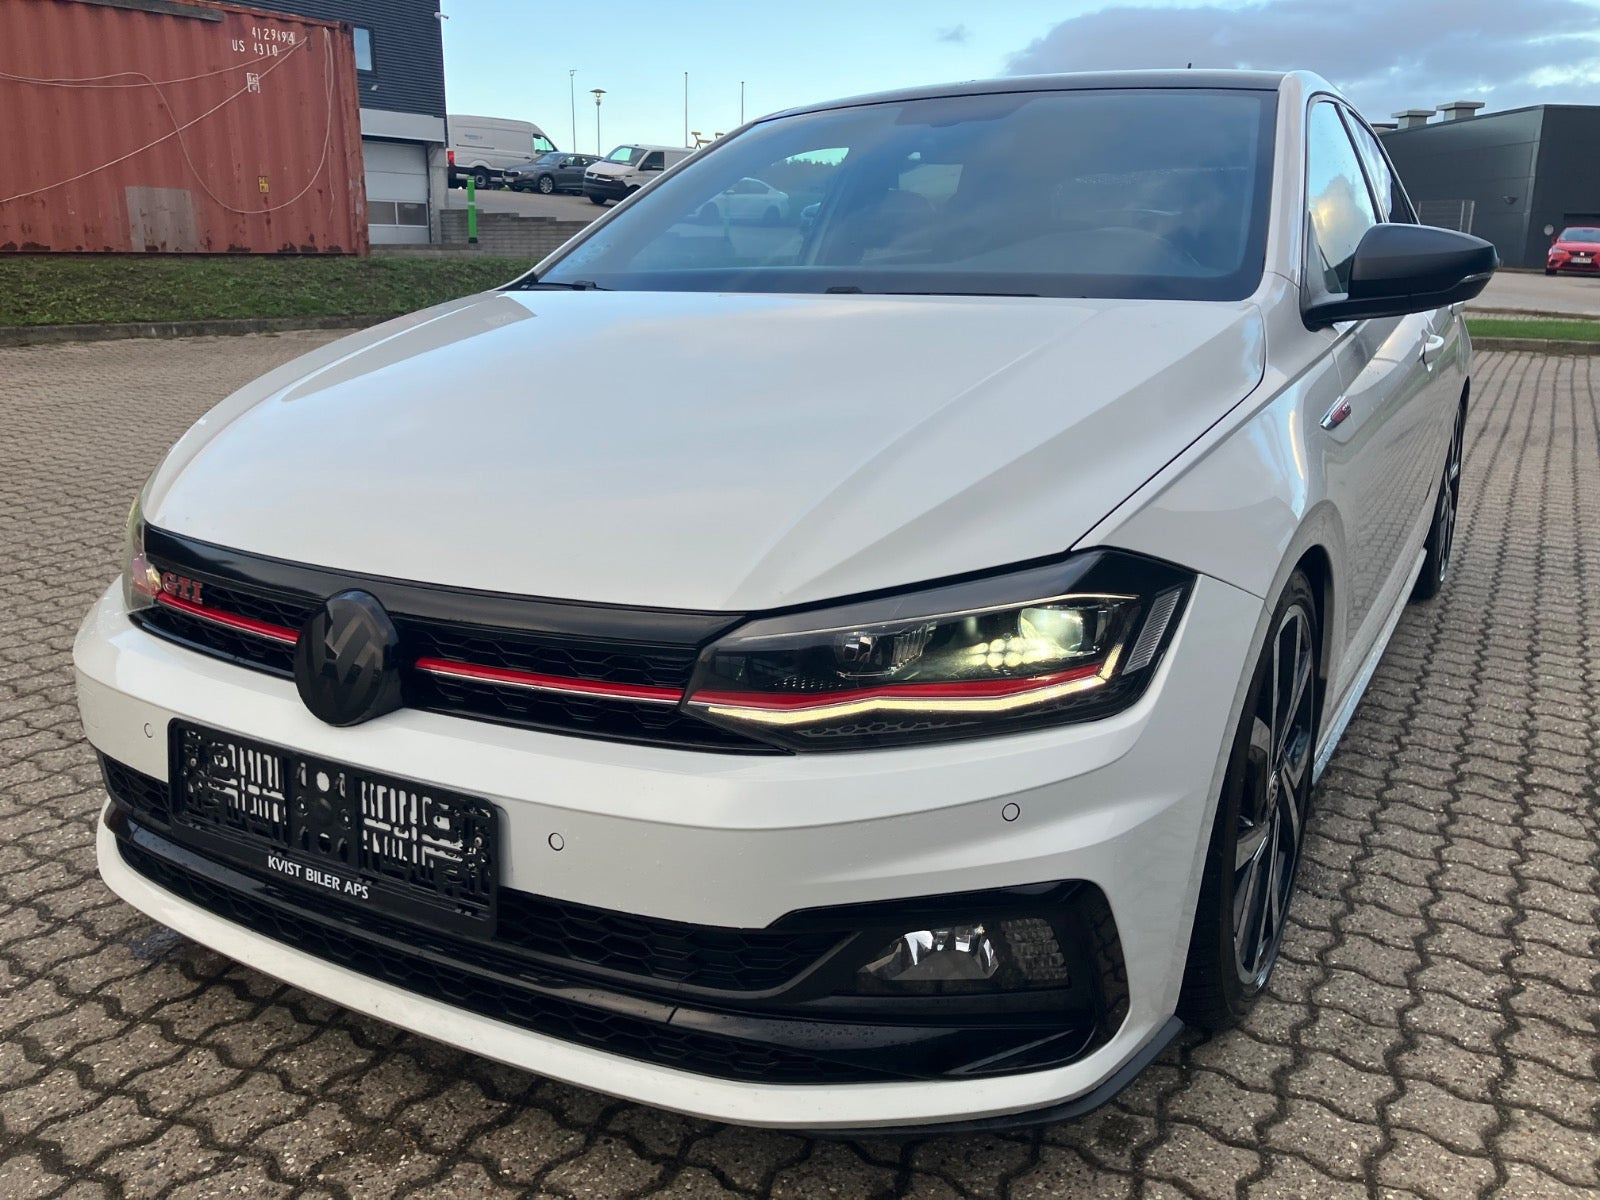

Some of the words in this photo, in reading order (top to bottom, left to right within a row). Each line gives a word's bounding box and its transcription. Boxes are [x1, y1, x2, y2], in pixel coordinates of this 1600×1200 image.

[231, 39, 245, 52] US
[253, 42, 278, 57] 4310
[161, 571, 203, 605] GTI
[268, 855, 302, 877] KVIST
[305, 868, 340, 891] BILER
[344, 881, 369, 899] APS
